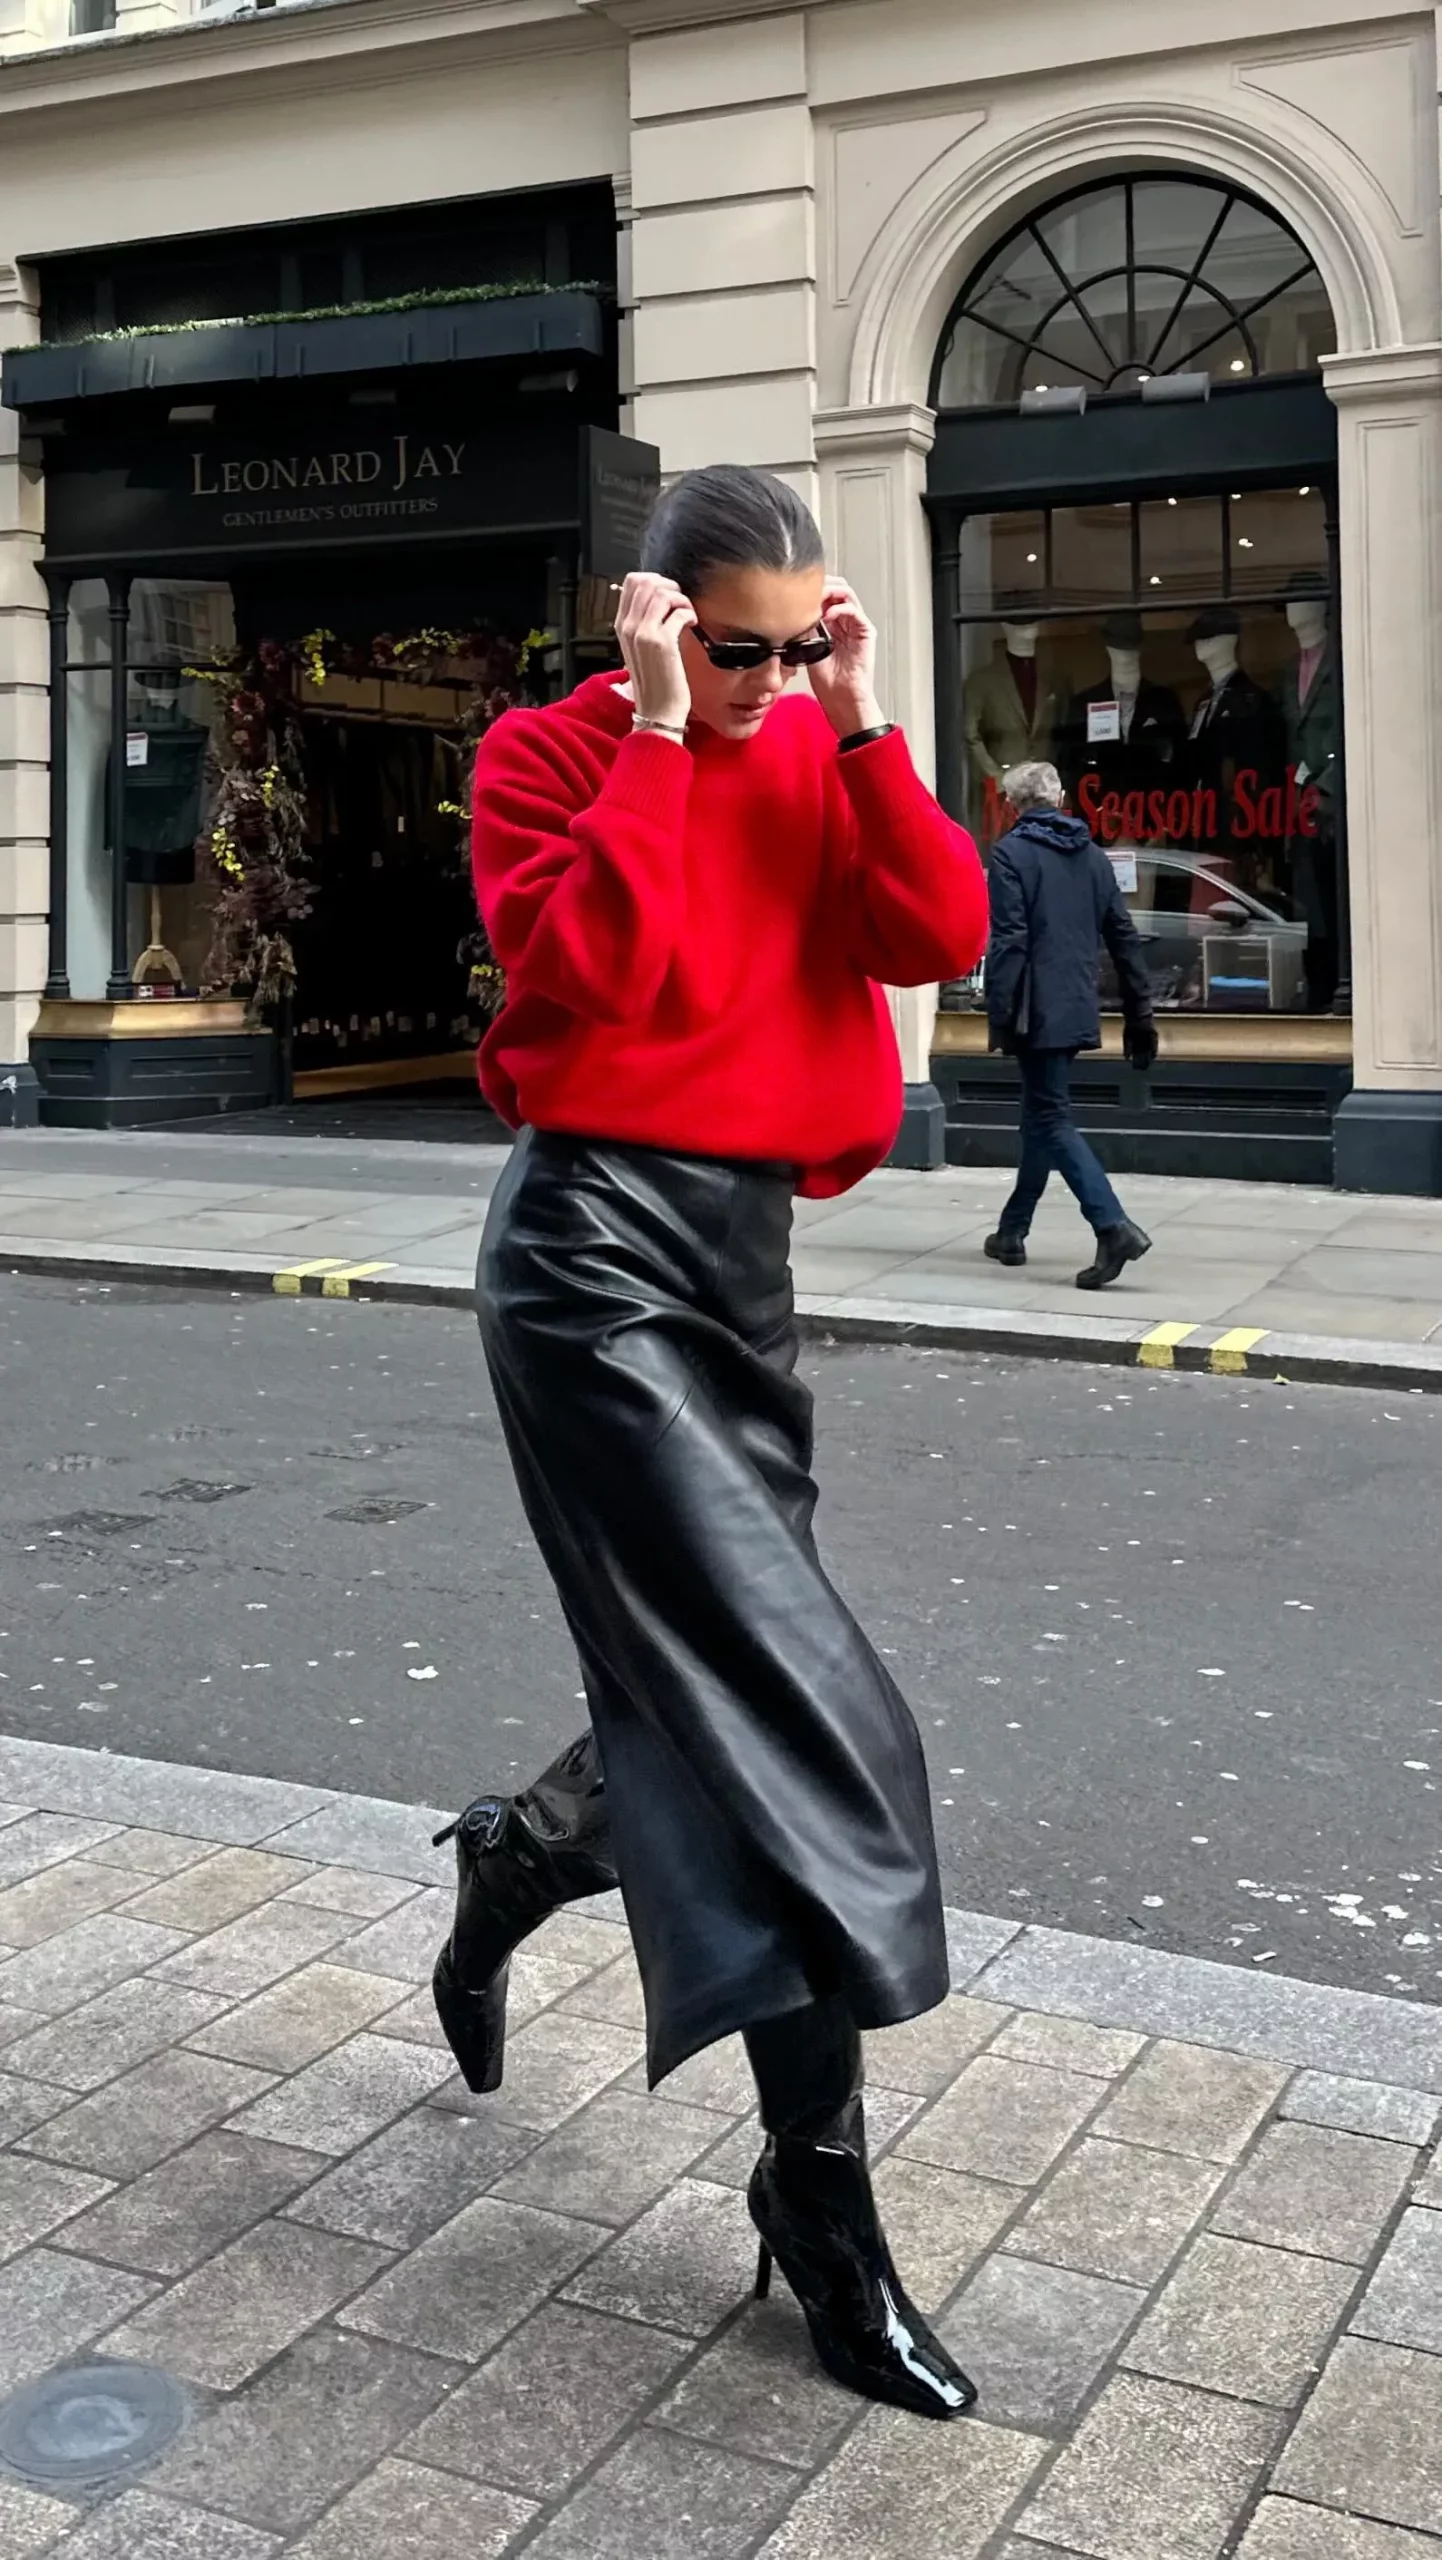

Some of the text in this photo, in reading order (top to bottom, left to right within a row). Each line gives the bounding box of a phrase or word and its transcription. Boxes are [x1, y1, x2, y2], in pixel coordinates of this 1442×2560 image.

[190, 435, 466, 495] LEONARD JAY
[222, 498, 438, 527] GENTLEMEN'S OUTFITTERS
[1232, 763, 1319, 839] Sale
